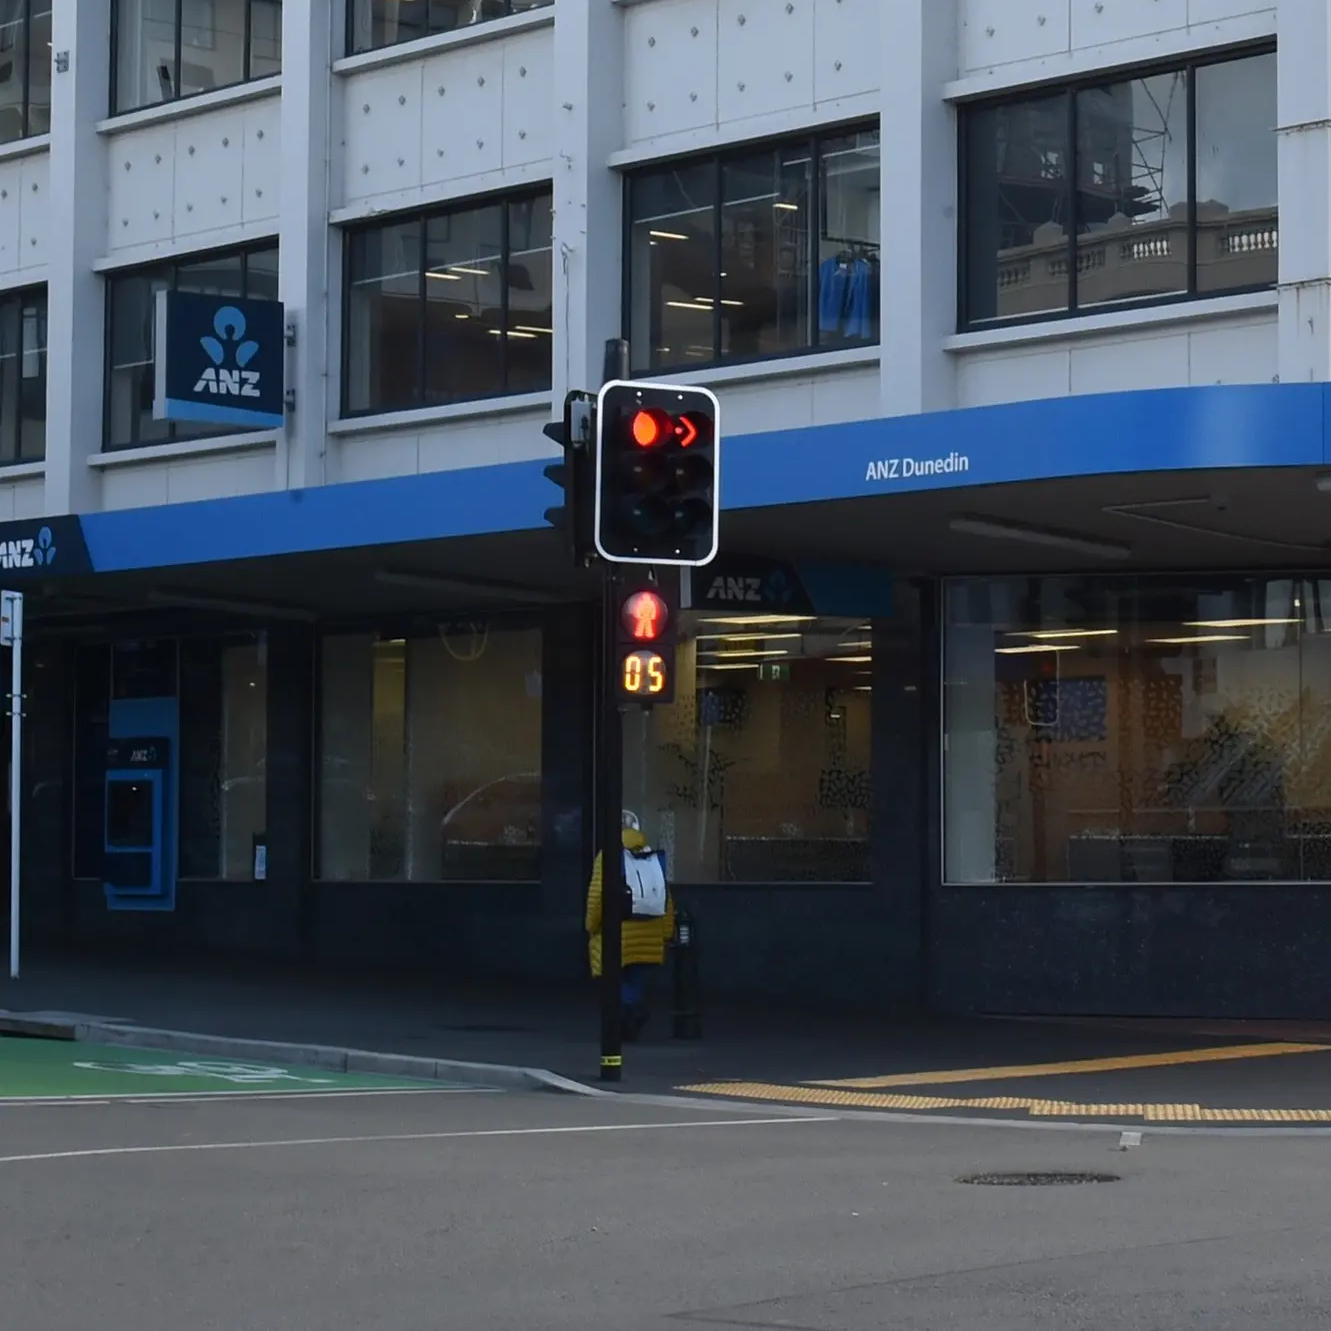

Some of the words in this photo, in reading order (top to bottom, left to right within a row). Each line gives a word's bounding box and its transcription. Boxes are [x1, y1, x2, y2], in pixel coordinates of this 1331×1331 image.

[193, 367, 261, 397] ANZ
[865, 458, 899, 482] ANZ
[902, 451, 970, 478] Dunedin
[706, 576, 762, 602] ANZ
[625, 655, 664, 693] 05
